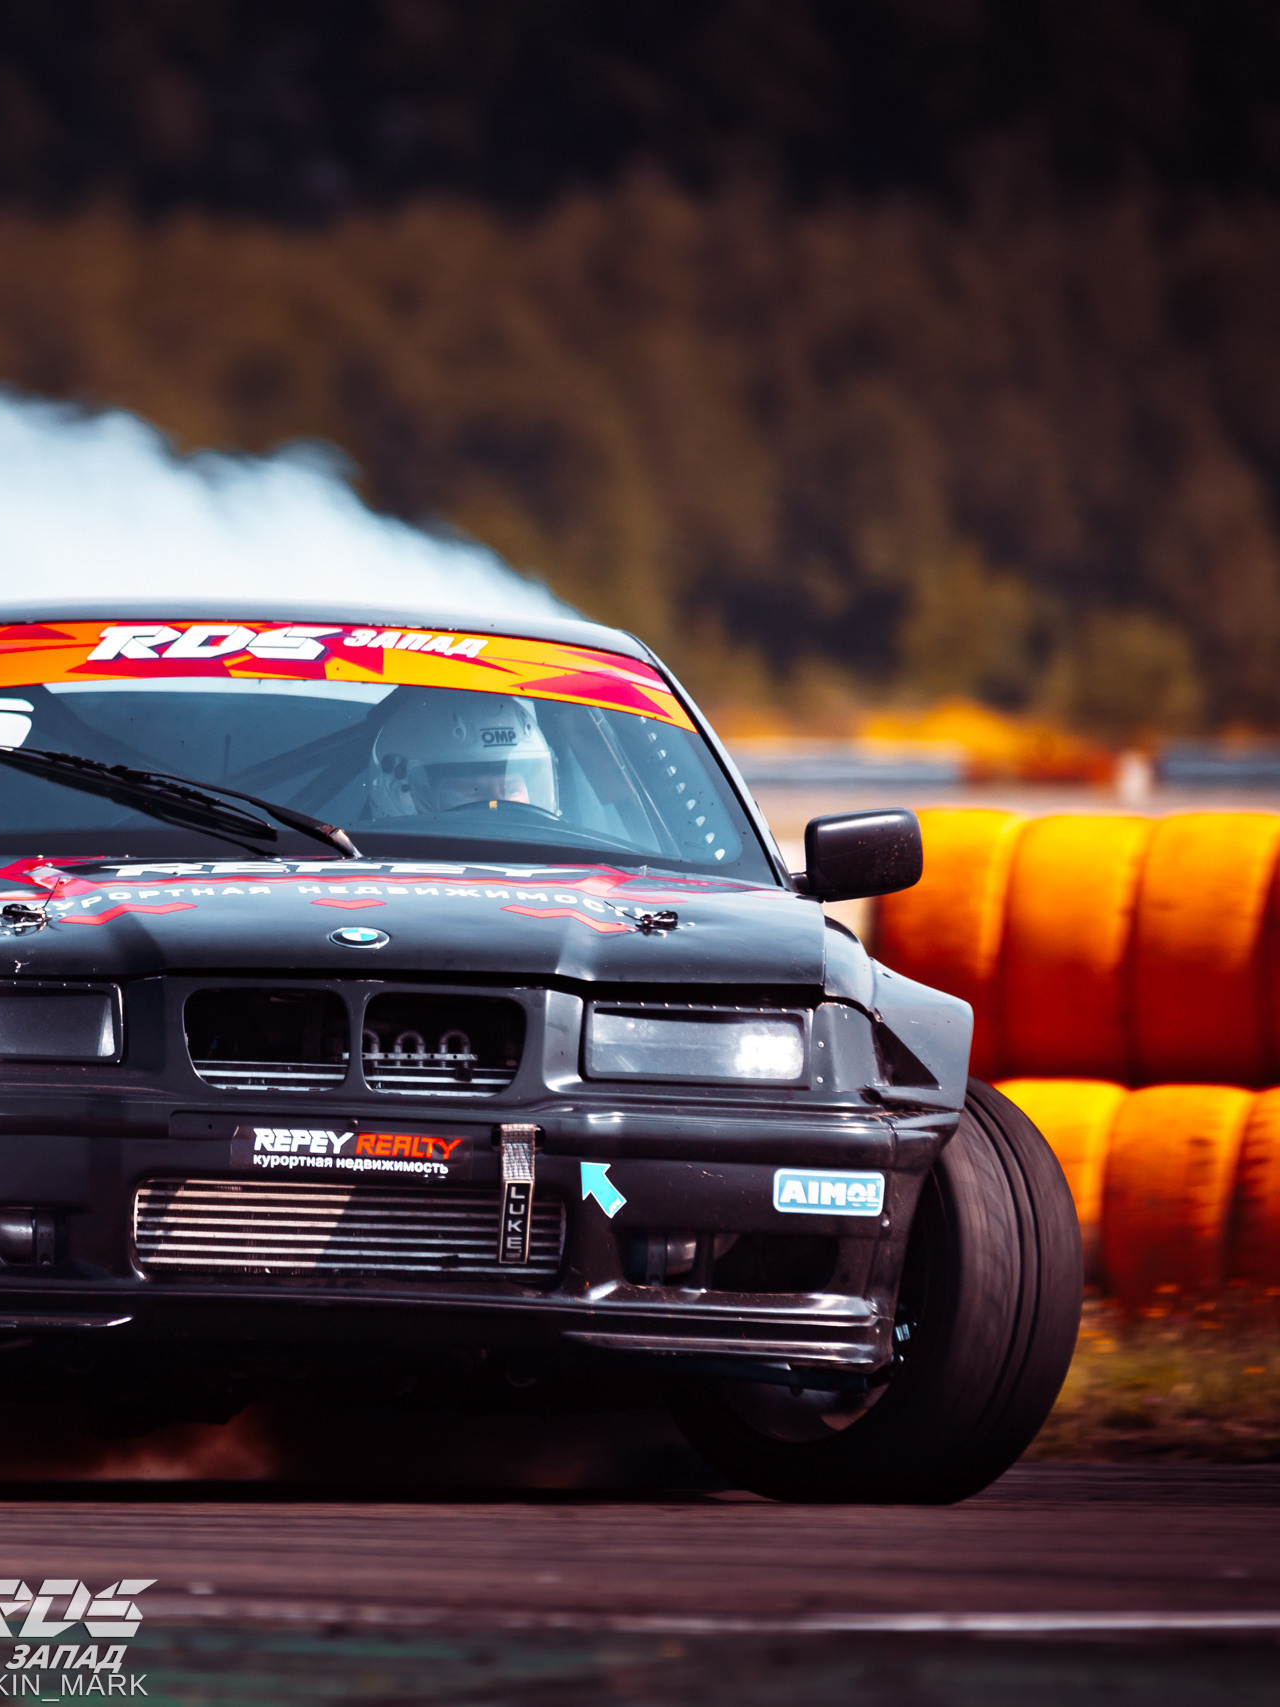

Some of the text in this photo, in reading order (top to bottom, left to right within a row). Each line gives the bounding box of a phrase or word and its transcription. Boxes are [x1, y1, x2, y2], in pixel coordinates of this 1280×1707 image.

[86, 625, 343, 661] RDS
[343, 628, 489, 659] ЗАПАД
[481, 730, 517, 745] OMP
[253, 1127, 464, 1160] REPEY REALTY
[253, 1154, 449, 1175] курортная недвижимость
[780, 1179, 881, 1208] AIMOL
[506, 1186, 526, 1250] LUKE
